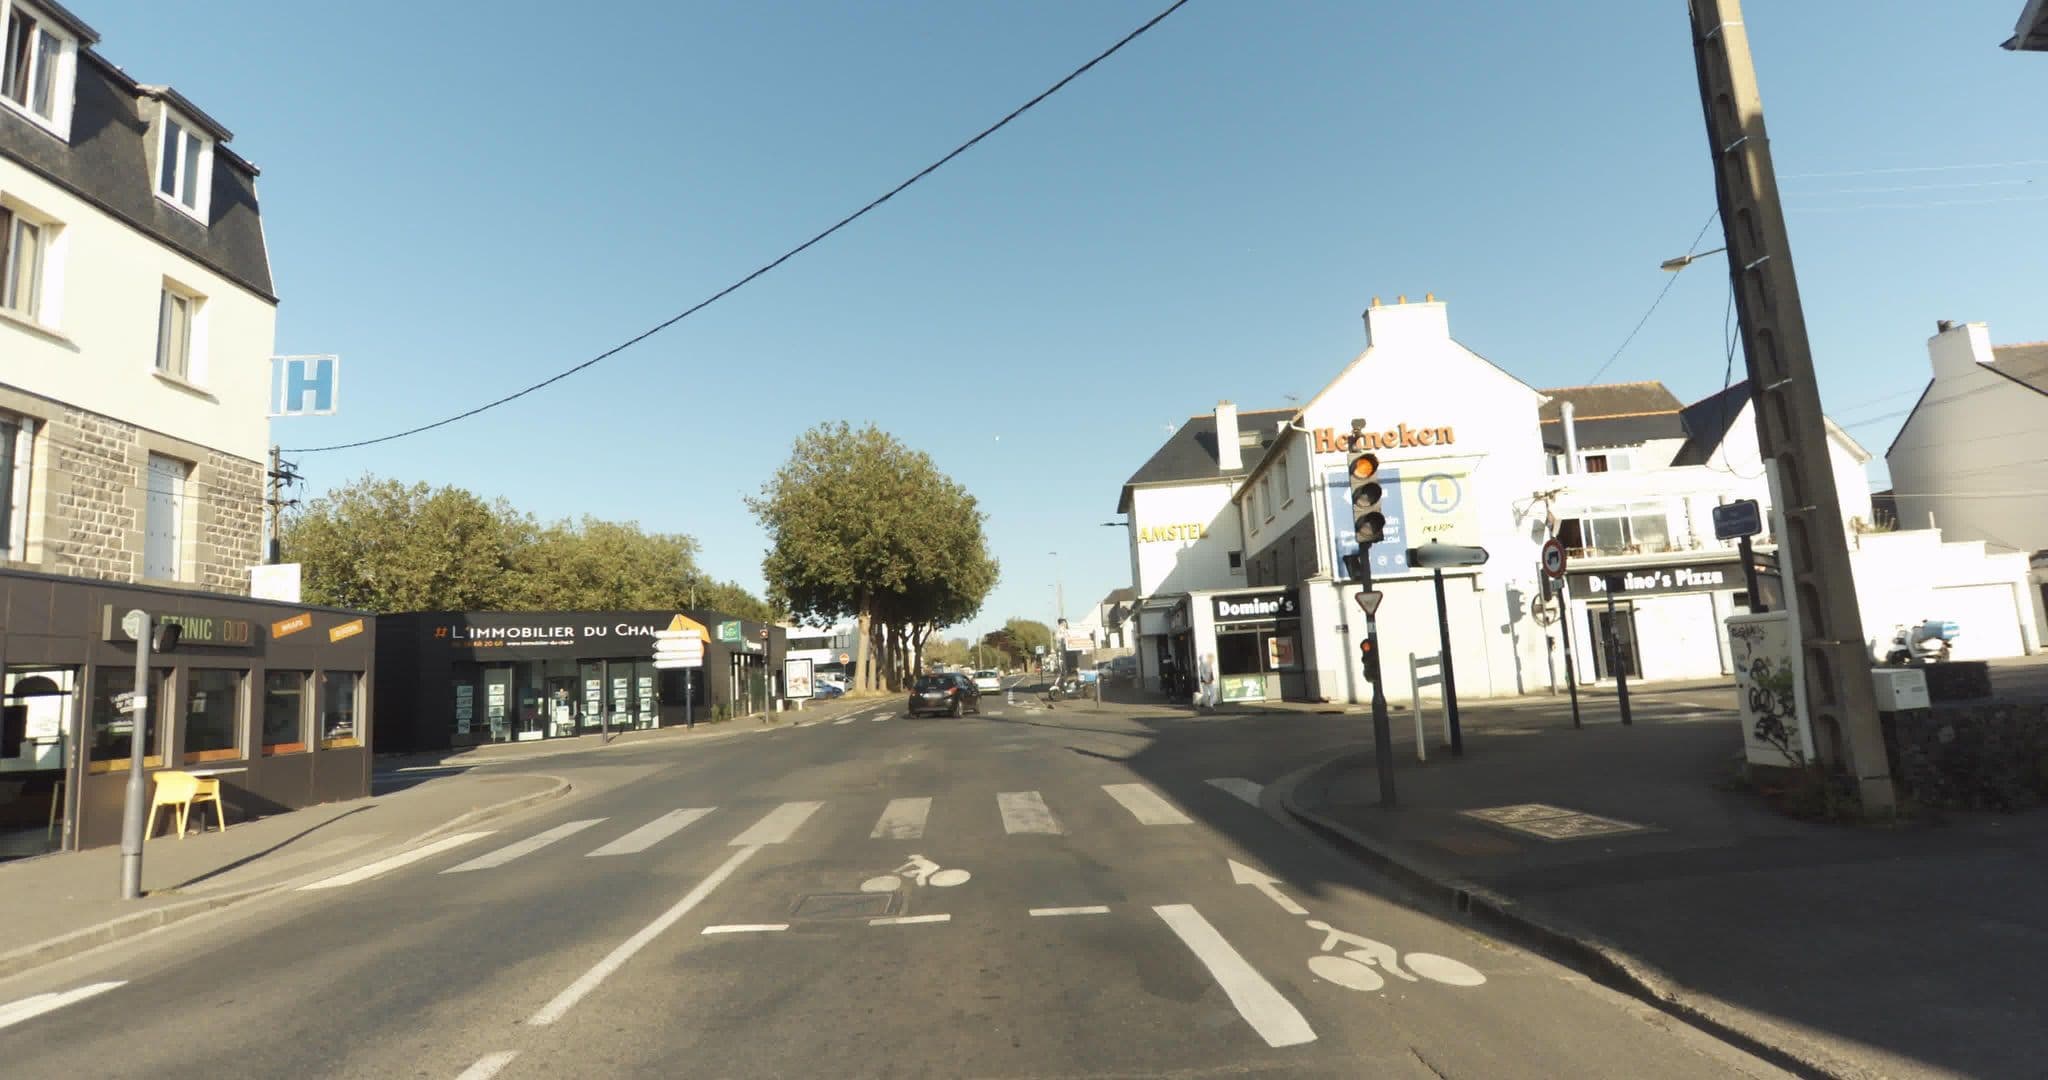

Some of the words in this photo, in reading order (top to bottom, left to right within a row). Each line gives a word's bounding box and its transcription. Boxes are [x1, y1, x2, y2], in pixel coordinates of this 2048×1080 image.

[287, 360, 333, 411] H
[1138, 522, 1209, 543] AMSTEL
[1589, 571, 1672, 592] Dino's
[1675, 568, 1724, 587] Pizza
[1218, 597, 1294, 617] Domino's
